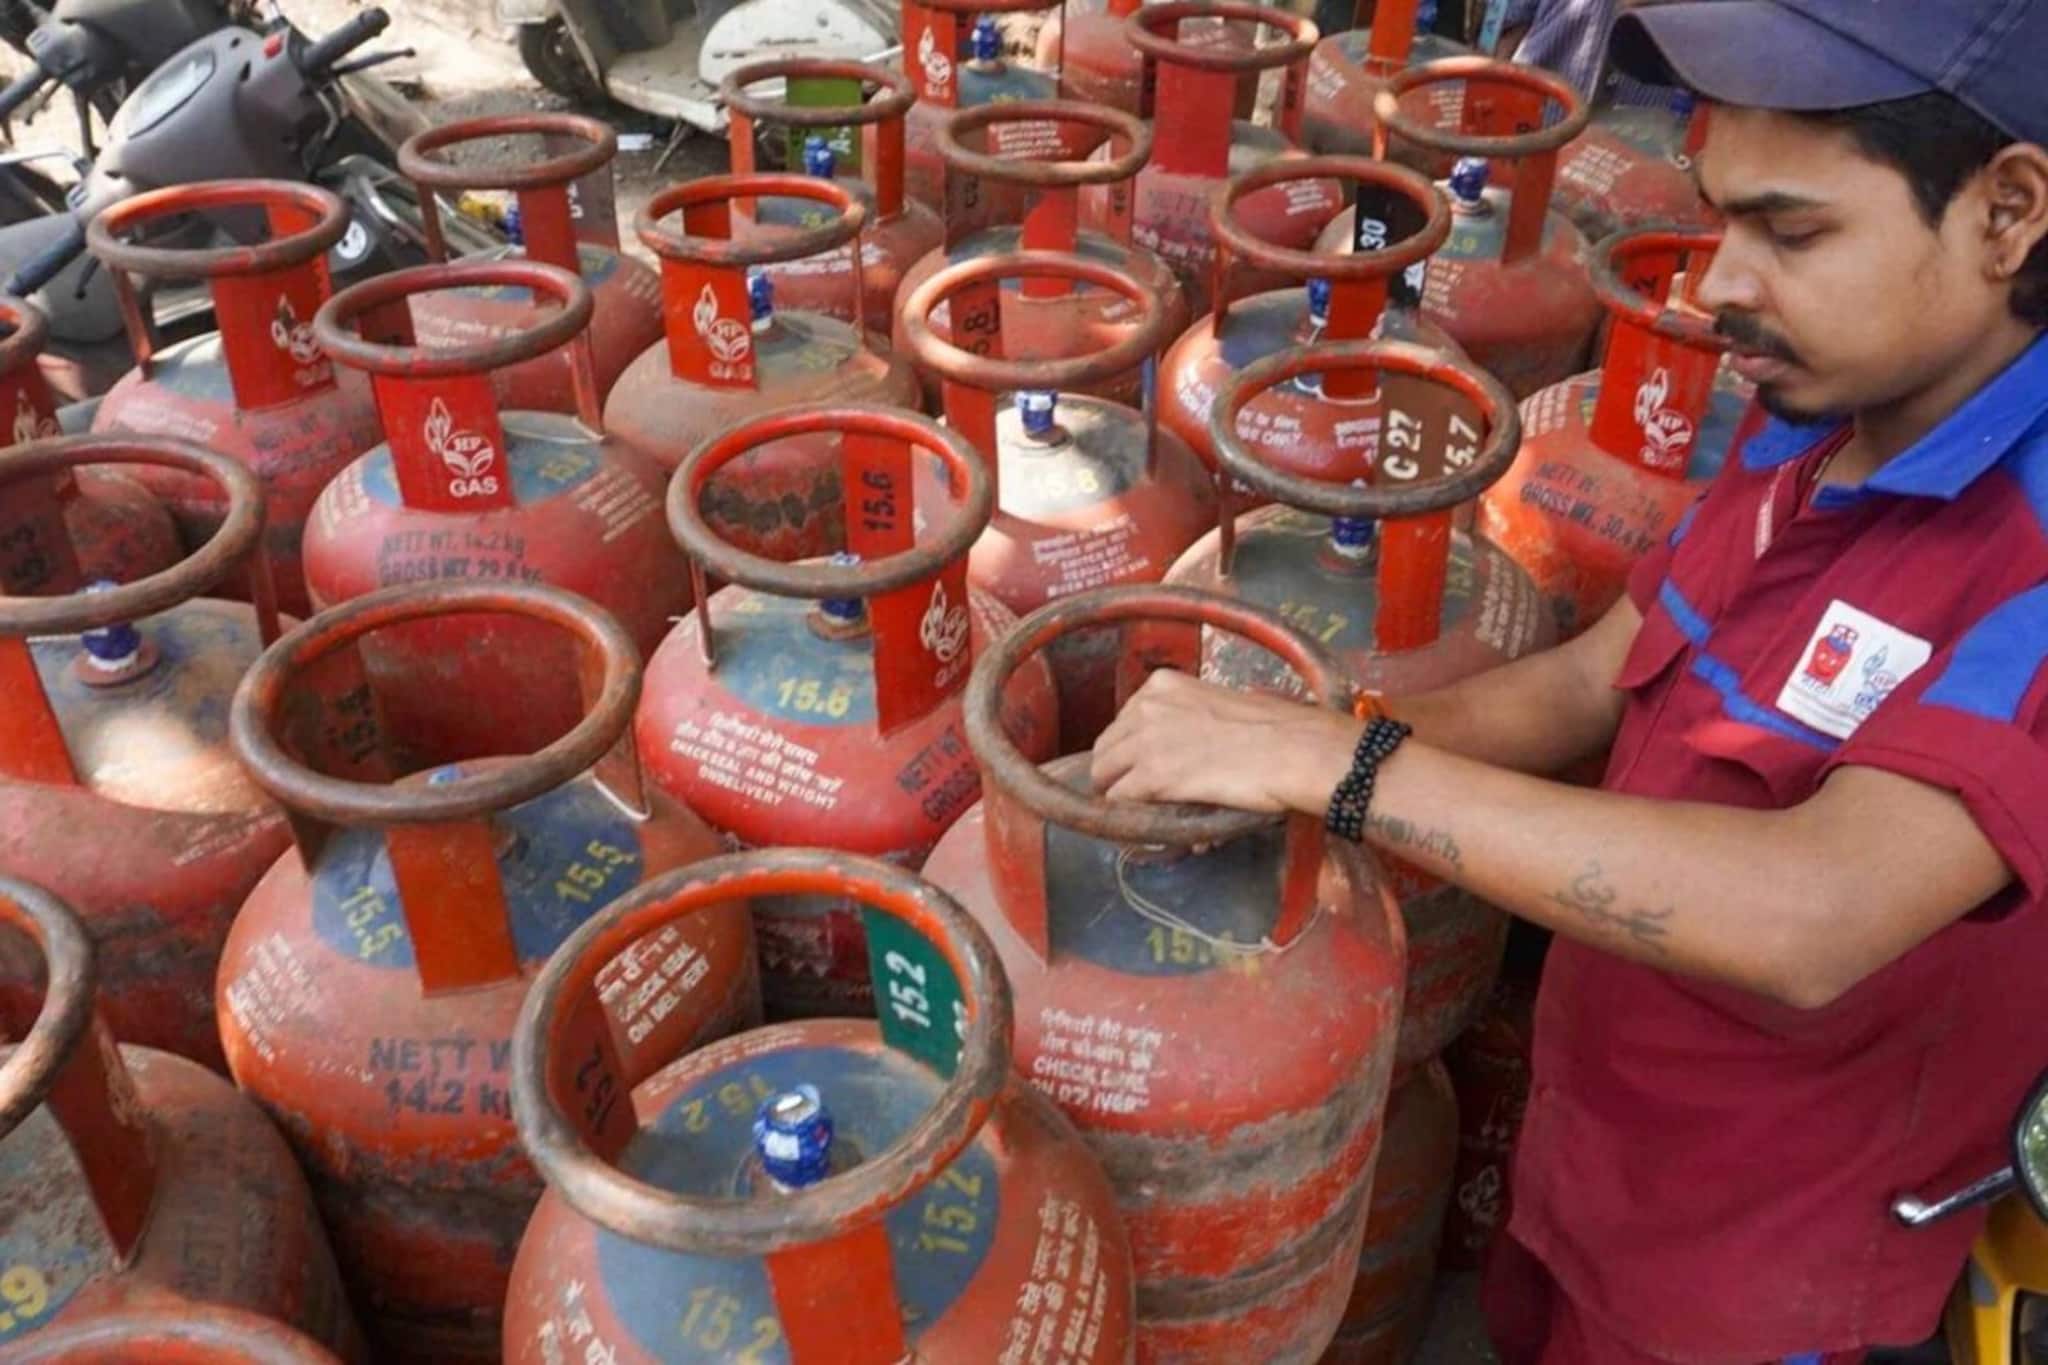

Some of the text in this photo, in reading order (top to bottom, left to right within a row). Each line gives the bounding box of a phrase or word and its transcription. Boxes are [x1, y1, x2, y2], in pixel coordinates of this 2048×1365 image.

[449, 475, 499, 498] GAS
[861, 470, 894, 531] 15.6
[776, 678, 852, 718] 15.6
[555, 838, 638, 903] 15.5
[340, 884, 404, 959] 15.5
[884, 950, 931, 1029] 15.2
[368, 1036, 477, 1074] NETT
[1033, 1054, 1098, 1087] CHECK
[386, 1080, 465, 1116] 14.2
[0, 1264, 48, 1331] .9
